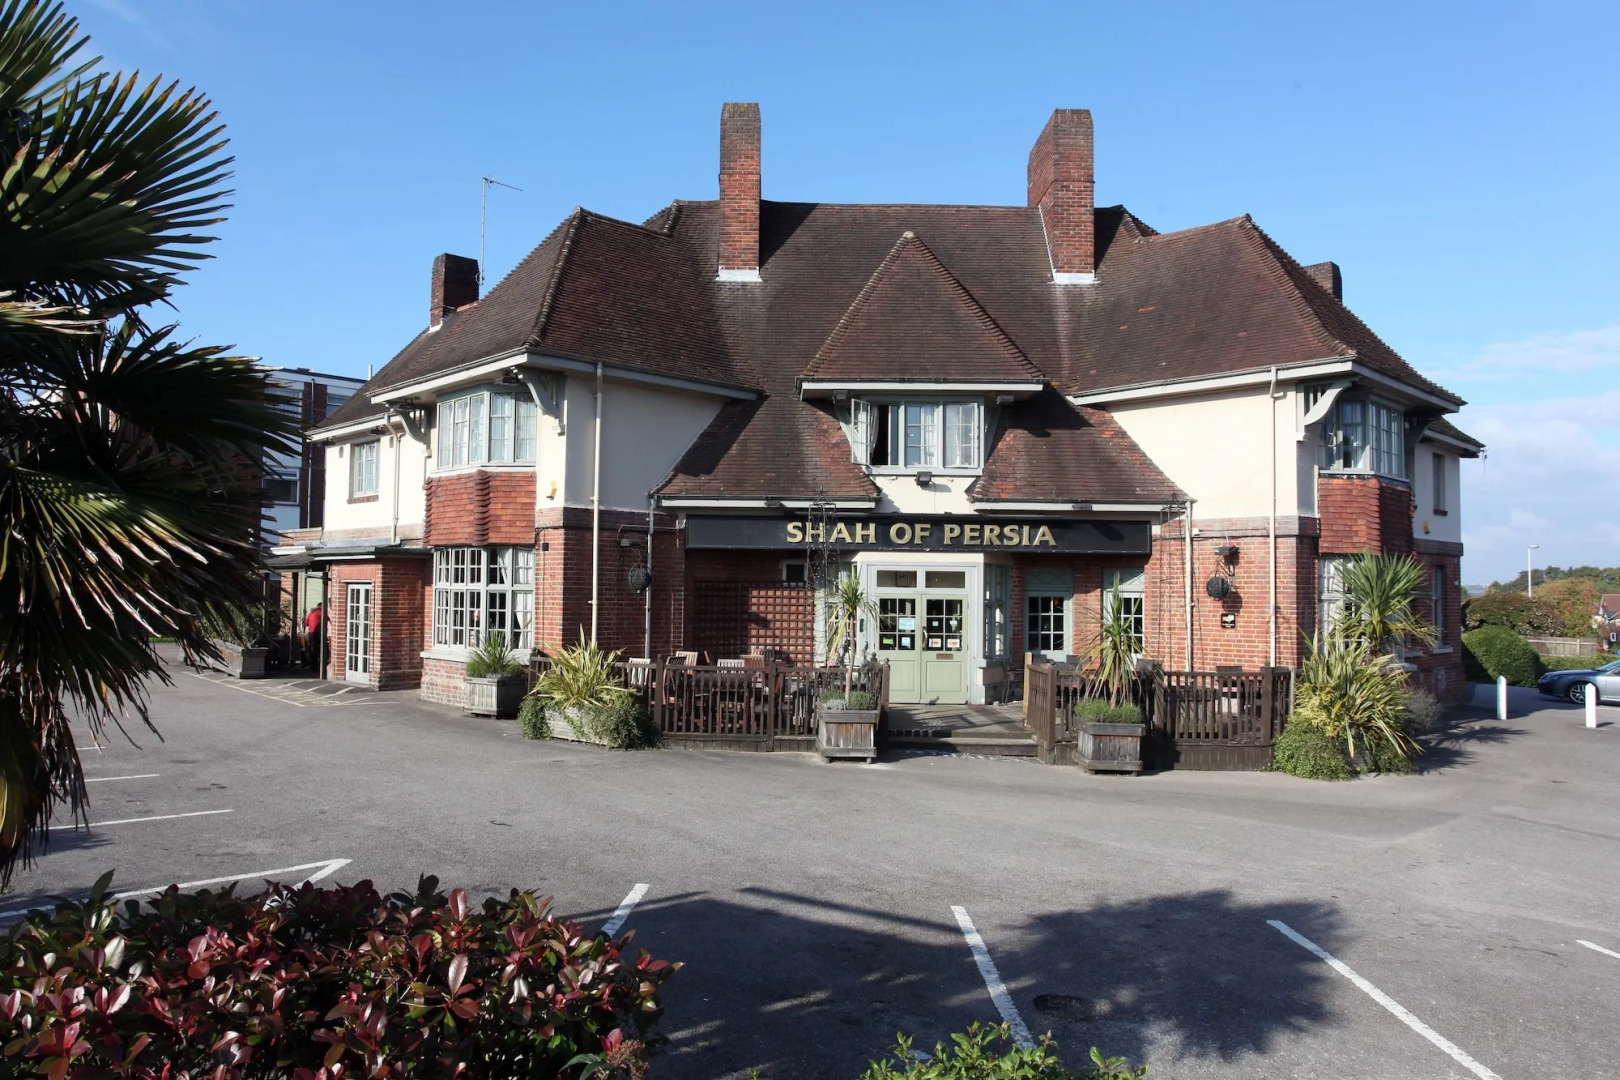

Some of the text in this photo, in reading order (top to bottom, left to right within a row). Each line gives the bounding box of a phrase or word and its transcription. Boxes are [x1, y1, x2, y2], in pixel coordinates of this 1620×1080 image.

[786, 521, 1057, 546] SHAH OF PERSIA
